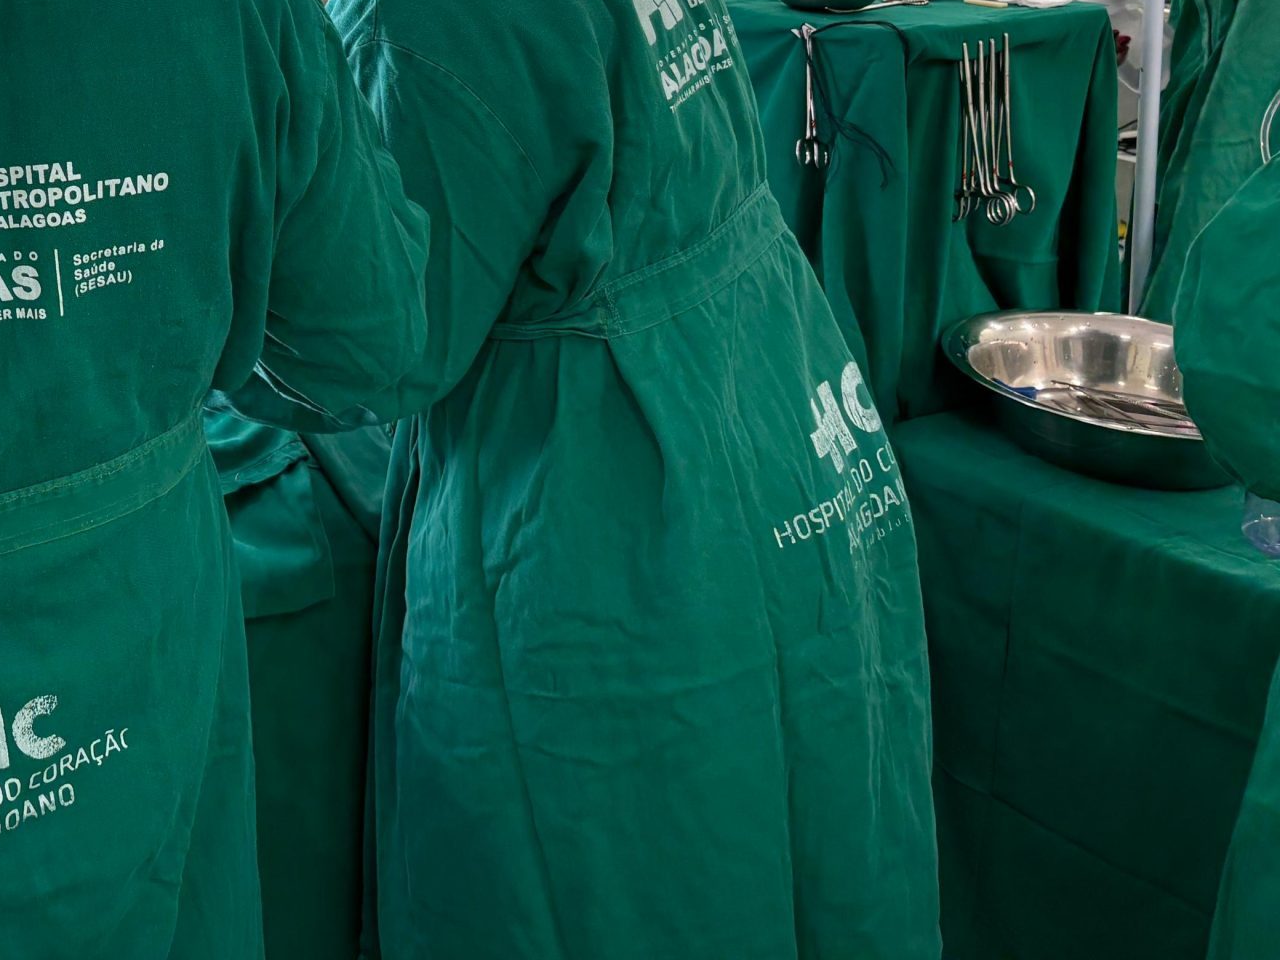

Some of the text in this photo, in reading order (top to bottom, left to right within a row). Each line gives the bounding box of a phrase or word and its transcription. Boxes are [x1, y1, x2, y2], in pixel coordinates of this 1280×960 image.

[73, 239, 164, 266] Secretaria da
[73, 261, 116, 281] Saúde
[75, 270, 133, 298] (SESAU)
[15, 307, 47, 320] MAIS
[773, 479, 856, 548] HOSPITAL
[850, 459, 873, 493] DO
